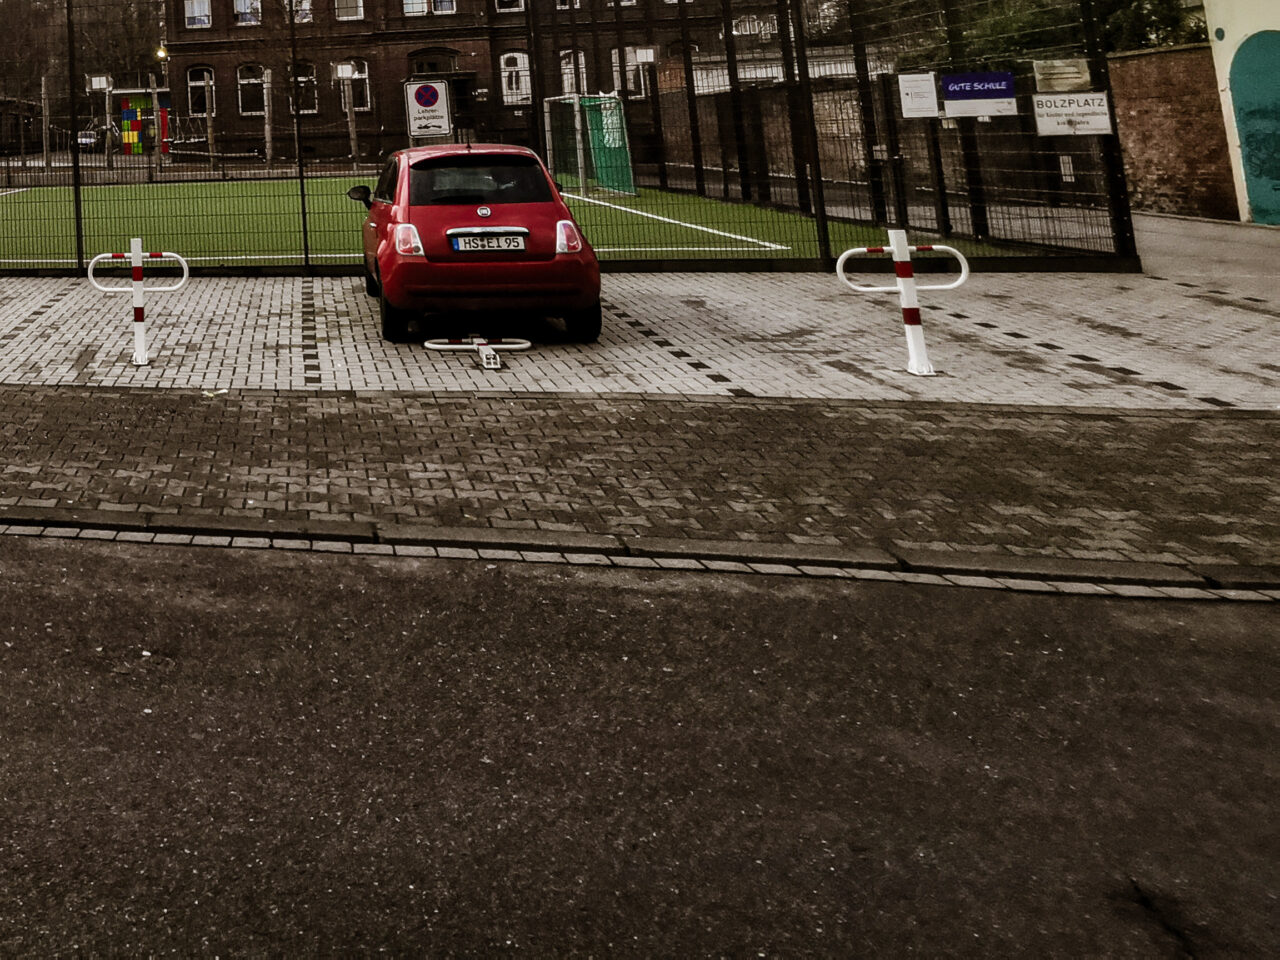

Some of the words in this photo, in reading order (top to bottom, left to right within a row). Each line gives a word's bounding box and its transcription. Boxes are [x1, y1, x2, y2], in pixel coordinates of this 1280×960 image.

[948, 83, 972, 91] GUTE
[973, 81, 1007, 90] SCHULE
[1036, 98, 1105, 109] BOLZPLATZ
[463, 238, 479, 249] HS
[504, 237, 520, 248] 95
